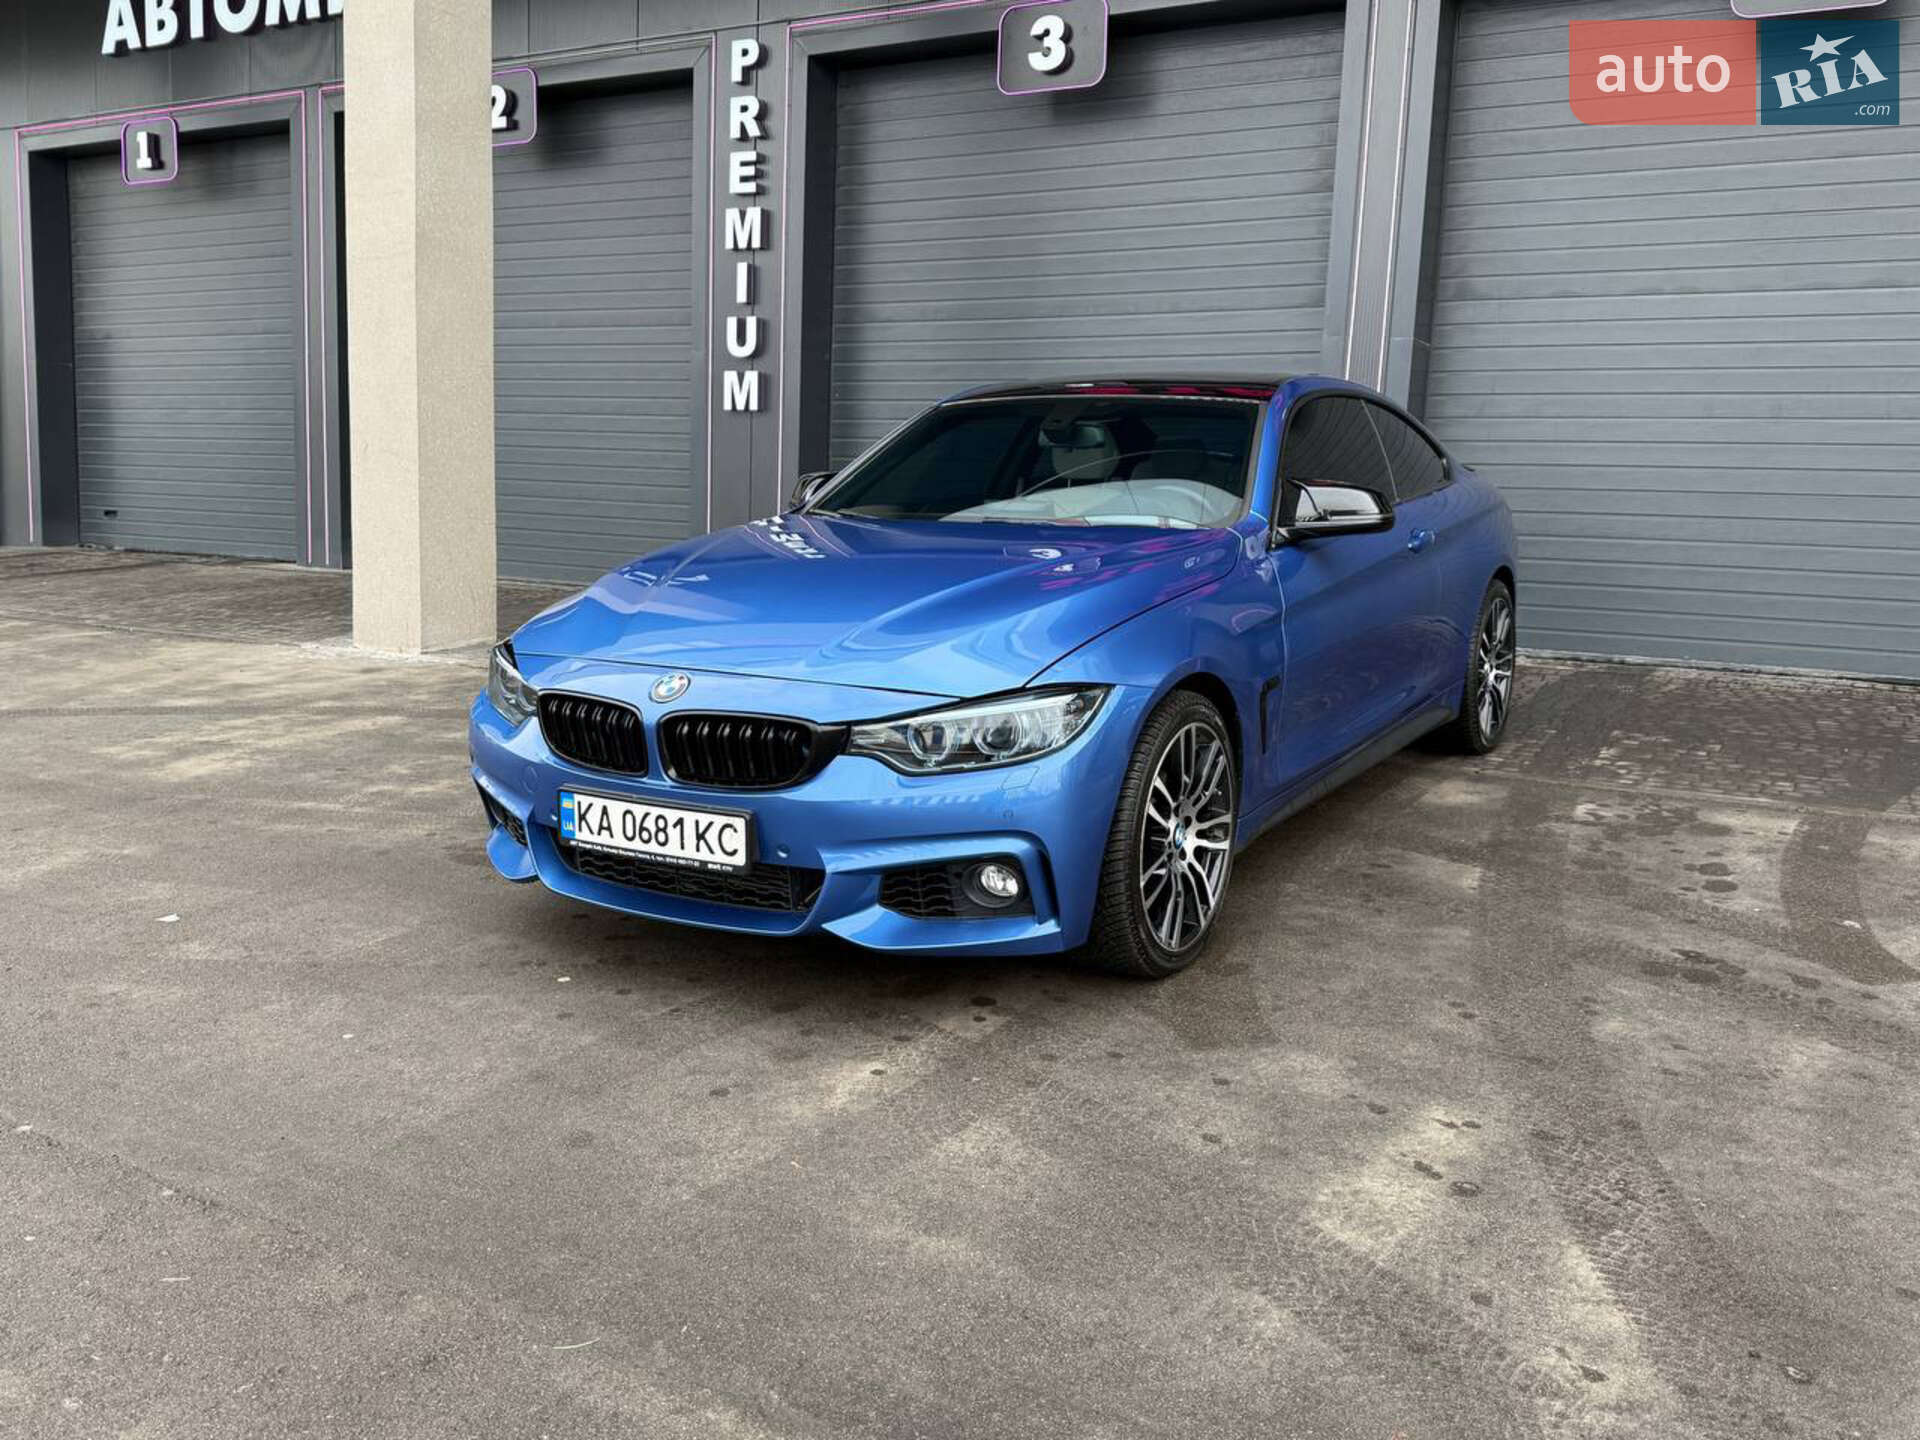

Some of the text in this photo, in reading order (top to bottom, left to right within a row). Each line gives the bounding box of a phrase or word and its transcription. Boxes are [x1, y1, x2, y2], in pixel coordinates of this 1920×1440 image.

[101, 0, 343, 55] АВТО
[1028, 15, 1067, 73] 3
[491, 85, 508, 129] 2
[136, 131, 153, 169] 1
[722, 38, 762, 412] PREMIUM
[577, 800, 614, 838] KA
[622, 809, 685, 851] 0681
[695, 818, 739, 857] KC
